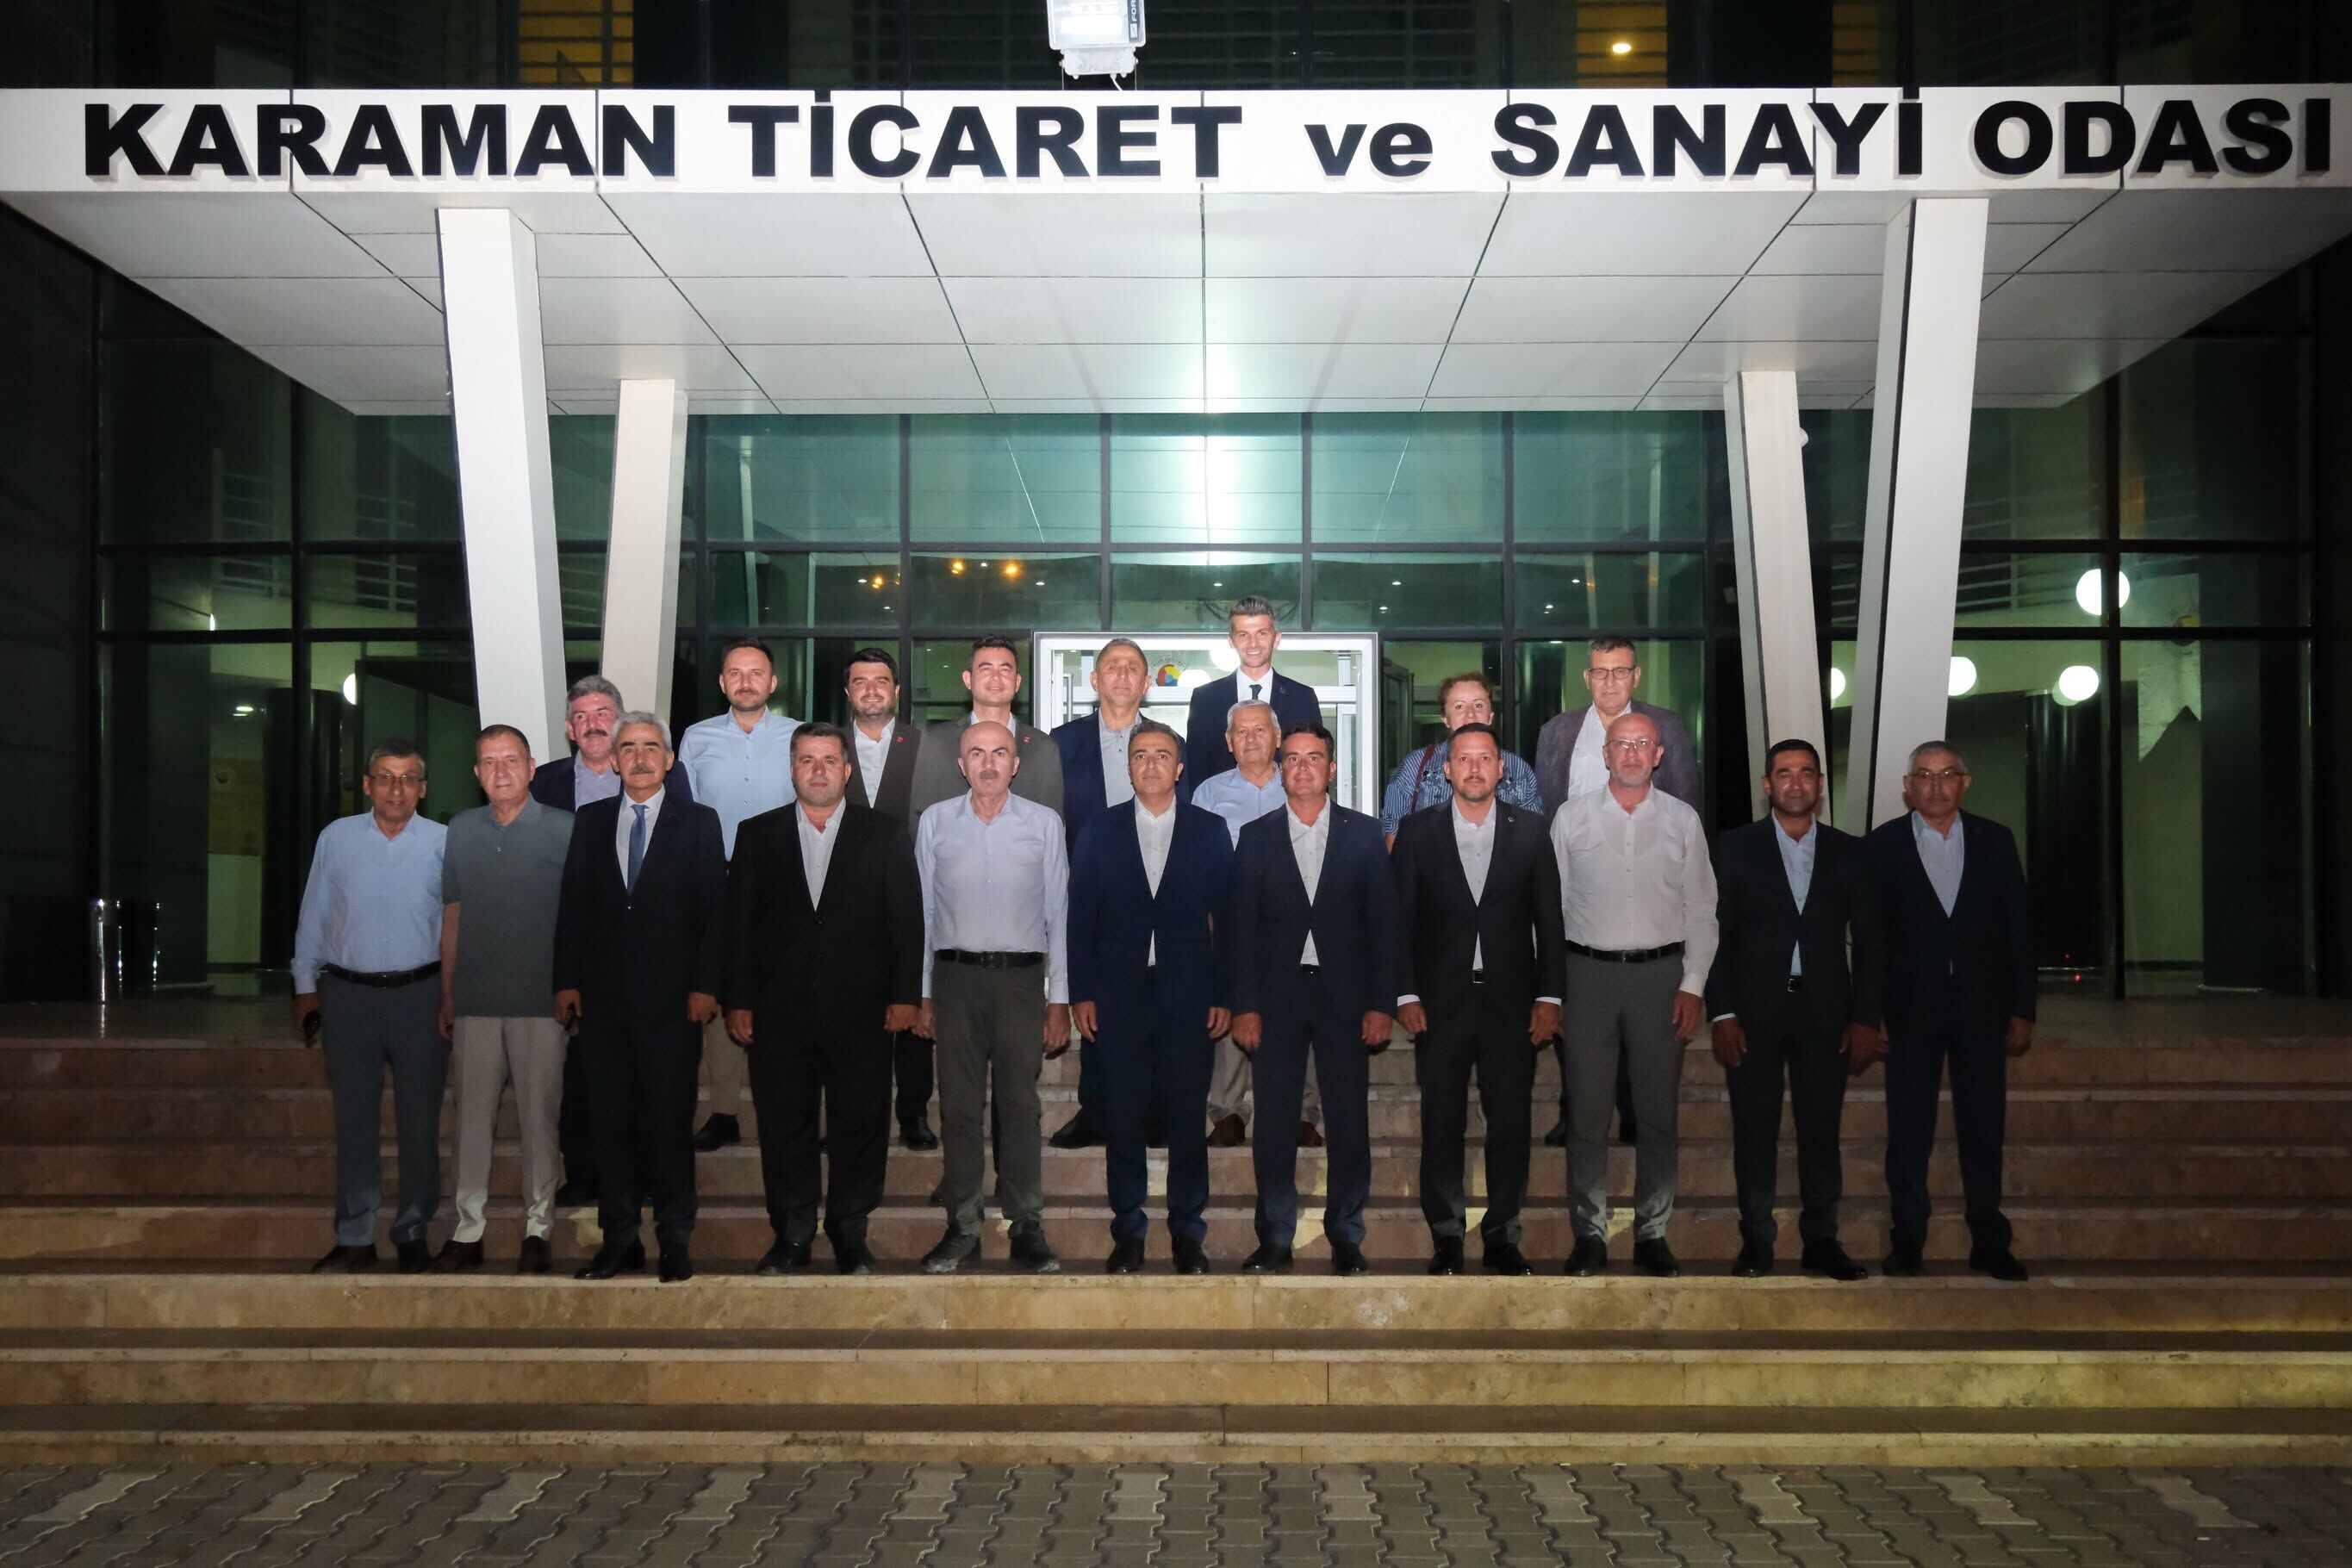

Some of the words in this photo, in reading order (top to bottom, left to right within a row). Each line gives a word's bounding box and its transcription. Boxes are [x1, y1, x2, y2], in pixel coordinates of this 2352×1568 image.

[84, 103, 675, 177] KARAMAN
[727, 89, 1243, 178] TİCARET
[1304, 122, 1434, 177] ve
[1490, 87, 1924, 177] SANAYİ
[1974, 98, 2331, 177] ODASI
